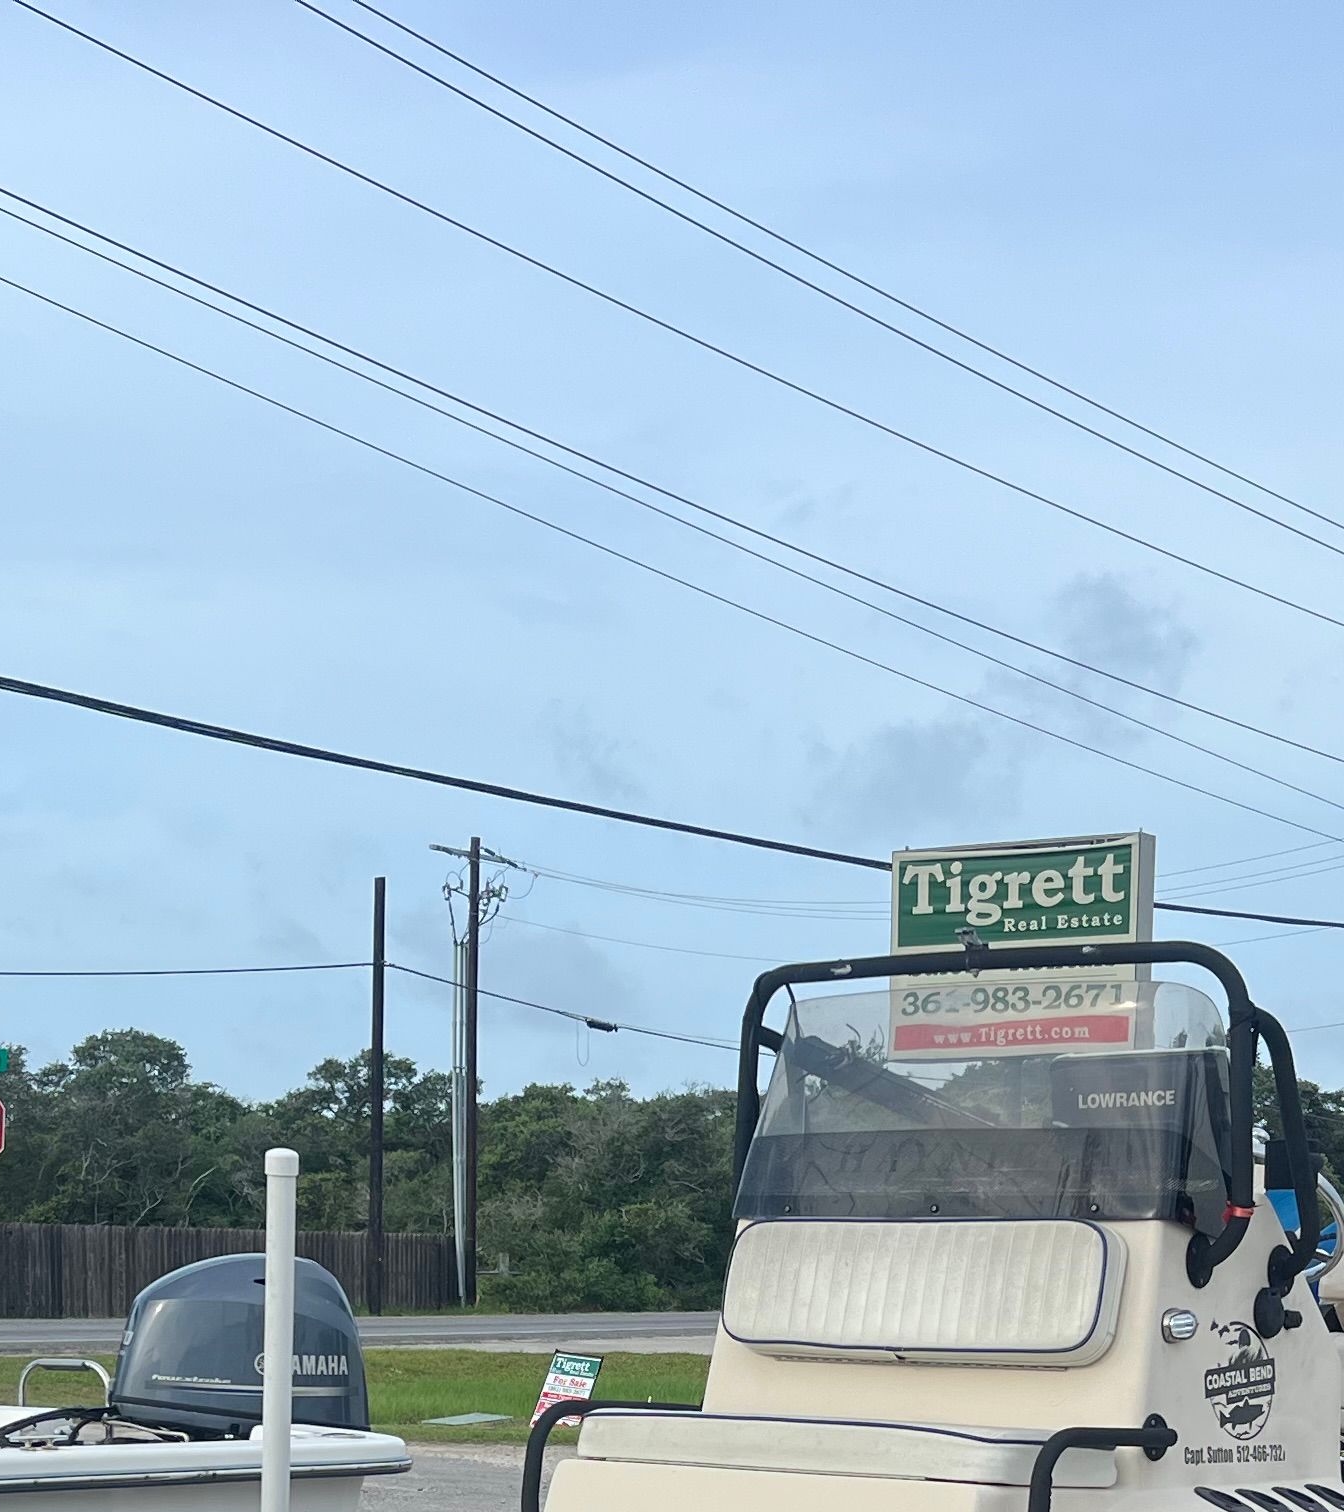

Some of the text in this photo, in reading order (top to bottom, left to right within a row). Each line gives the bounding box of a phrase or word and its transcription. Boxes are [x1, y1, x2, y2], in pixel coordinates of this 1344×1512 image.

[902, 853, 1125, 926] Tigrett
[1003, 912, 1123, 932] Real Estate
[933, 1024, 1090, 1046] www.Tigrett.com
[1078, 1089, 1176, 1109] LOWRANCE
[292, 1354, 349, 1376] AMAHA
[1206, 1365, 1274, 1390] COASTAL BEND
[1208, 1446, 1234, 1464] Sutton
